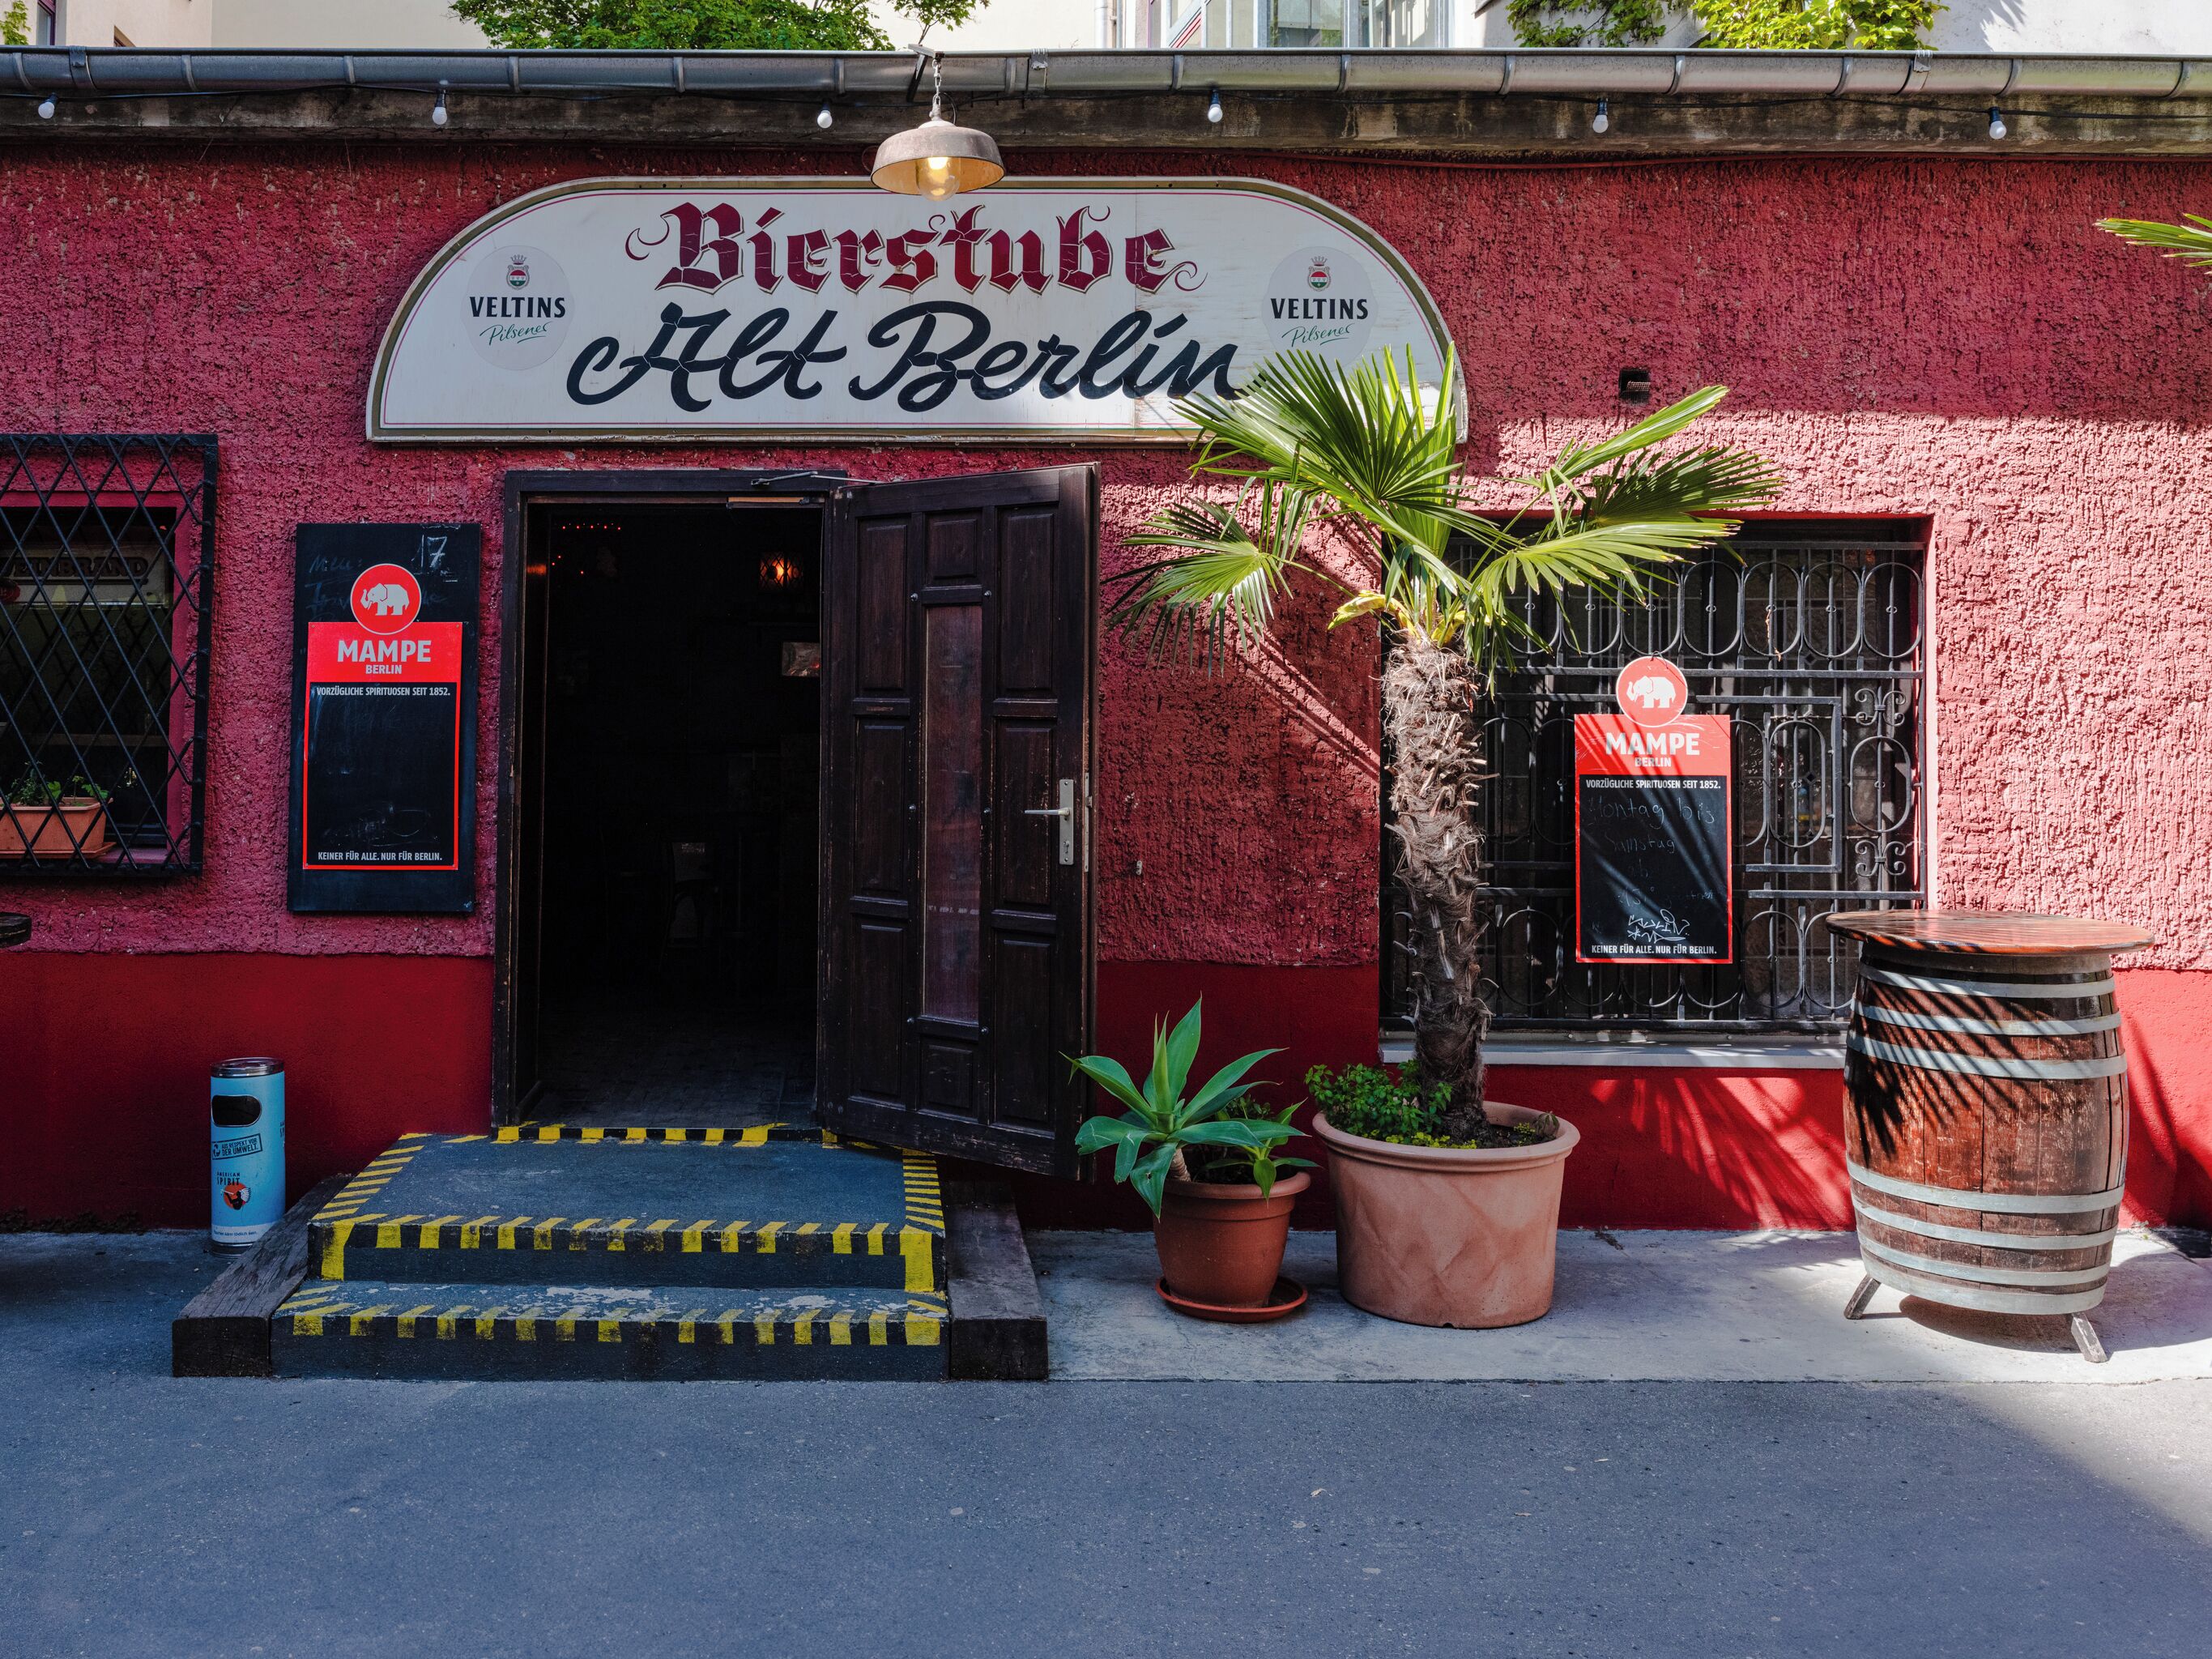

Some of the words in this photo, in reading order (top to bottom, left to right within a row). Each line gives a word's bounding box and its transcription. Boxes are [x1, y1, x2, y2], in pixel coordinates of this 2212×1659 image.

[625, 202, 1208, 295] Bierstube
[469, 296, 566, 318] VELTINS
[1270, 297, 1369, 320] VELTINS
[479, 321, 549, 346] Pilsener
[1281, 322, 1357, 347] Pilsener
[567, 301, 846, 412] Alt
[848, 301, 1265, 413] Berlin
[337, 640, 432, 663] MAMPE
[365, 664, 403, 675] BERLIN
[317, 685, 364, 696] VORZÜGLICHE
[365, 687, 411, 696] SPIRITUOSEN
[412, 687, 428, 696] SEIT
[429, 687, 451, 696] 1852.
[1605, 732, 1700, 755] MAMPE
[1634, 757, 1672, 767] BERLIN
[1586, 778, 1634, 789] VORZÜGLICHE
[1635, 779, 1681, 789] SPIRITUOSEN
[1682, 779, 1697, 789] SEIT
[1699, 779, 1721, 789] 1852.
[318, 851, 343, 861] KEINER
[345, 850, 360, 861] FÜR
[361, 851, 380, 861] ALLE.
[381, 851, 396, 861] NUR
[398, 850, 412, 861] FÜR
[414, 851, 442, 861] BERLIN.
[1592, 945, 1617, 954] KEINER
[1619, 944, 1634, 954] FÜR
[1635, 945, 1654, 954] ALLE.
[1656, 945, 1671, 954] NUR
[1673, 944, 1687, 954] FÜR
[1689, 945, 1717, 954] BERLIN.
[228, 1140, 247, 1148] RESPEKT
[216, 1176, 241, 1185] SPIRIT
